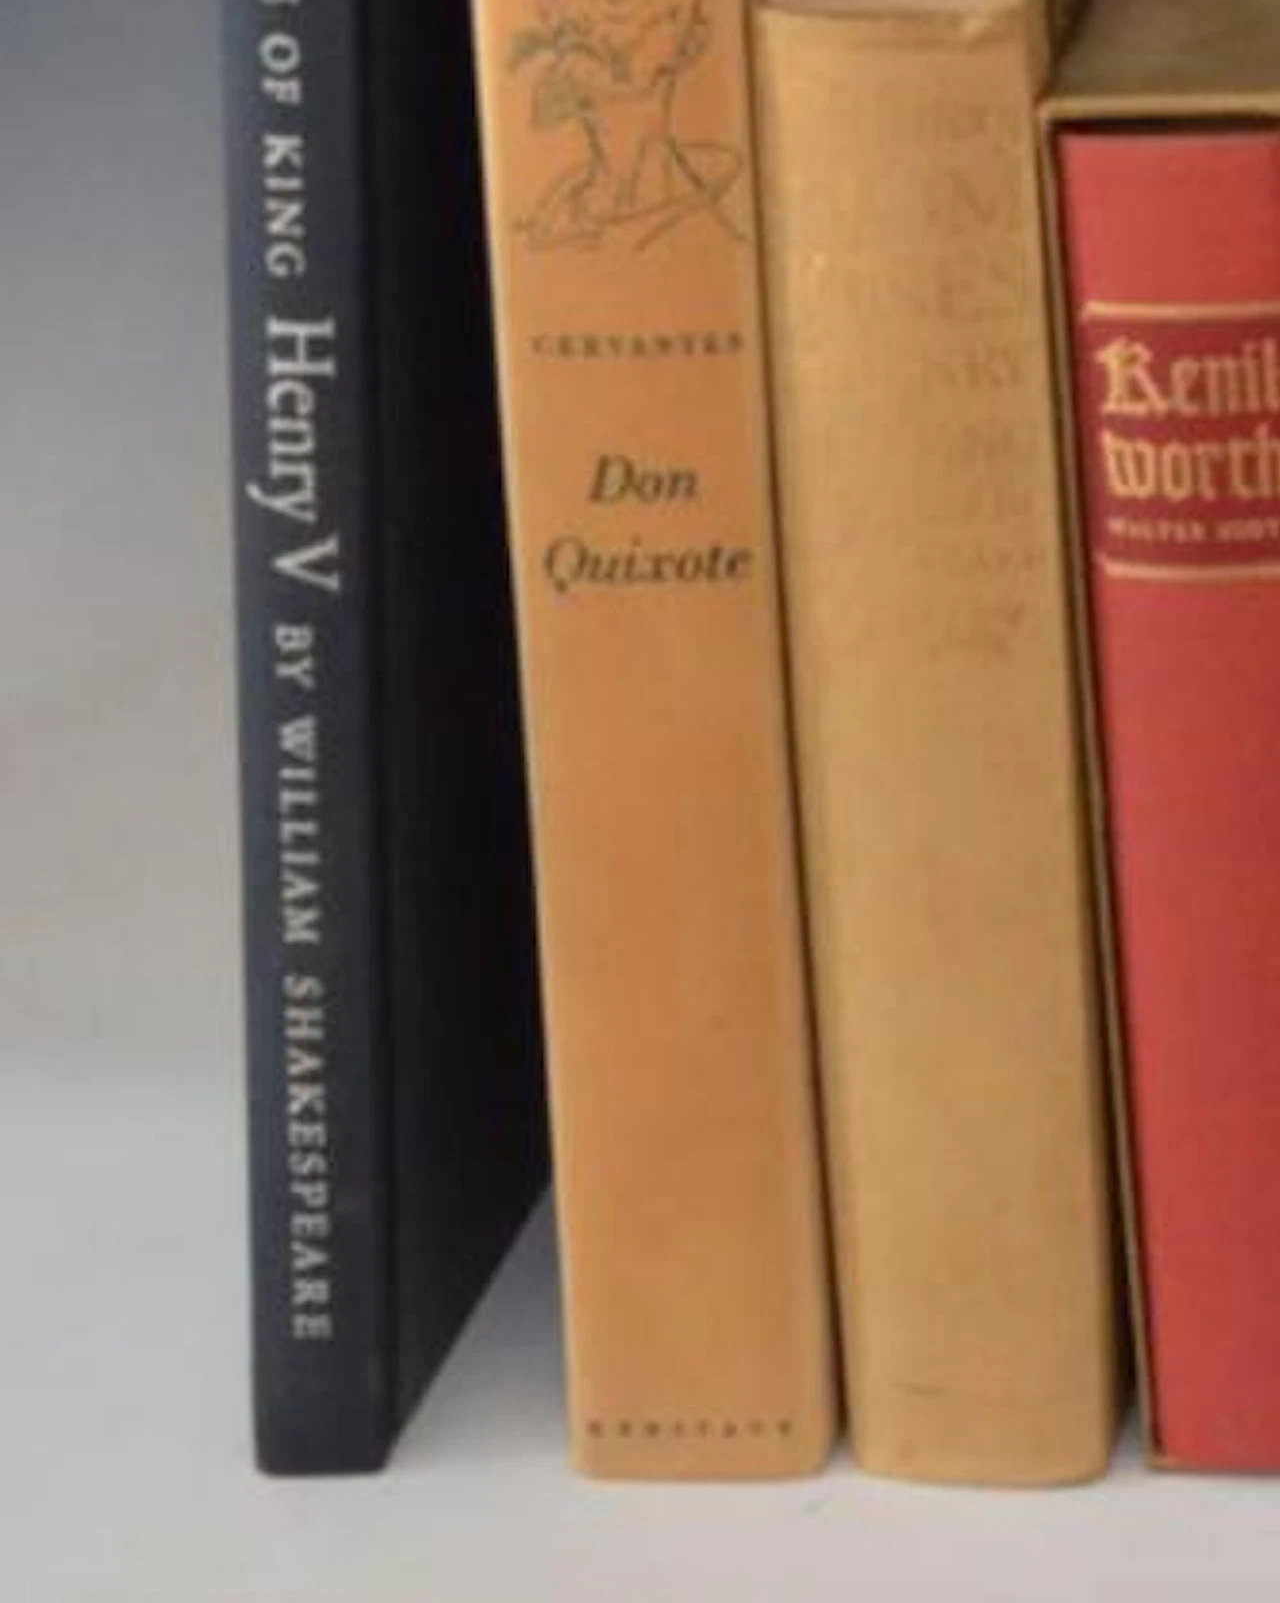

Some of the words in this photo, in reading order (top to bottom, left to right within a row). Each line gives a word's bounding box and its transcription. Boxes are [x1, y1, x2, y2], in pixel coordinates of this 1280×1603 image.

[260, 32, 302, 104] OF
[262, 133, 307, 278] KING
[246, 316, 336, 523] Henry
[590, 454, 698, 503] Don
[272, 537, 341, 590] V
[544, 535, 752, 593] Quixote
[274, 623, 314, 689] BY
[278, 716, 323, 945] WILLIAM
[283, 975, 333, 1340] SHAKESPEARE
